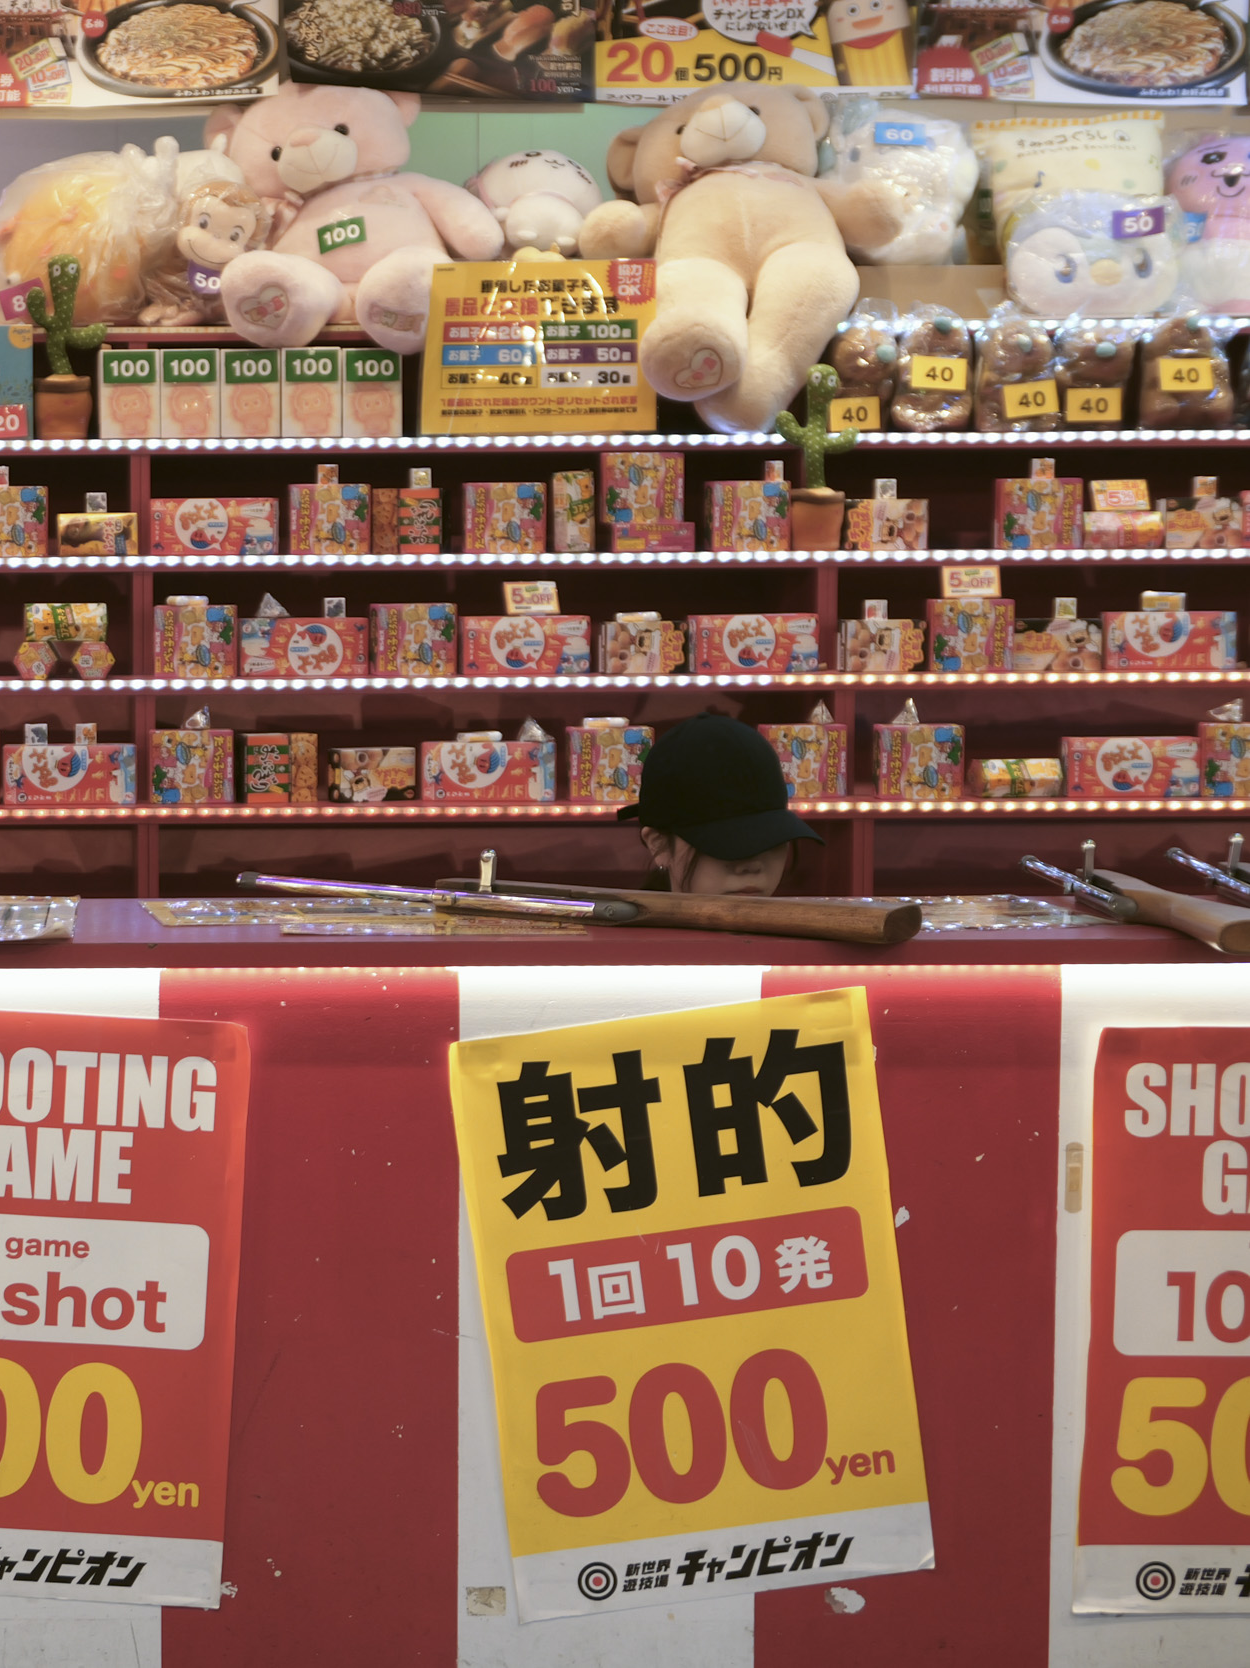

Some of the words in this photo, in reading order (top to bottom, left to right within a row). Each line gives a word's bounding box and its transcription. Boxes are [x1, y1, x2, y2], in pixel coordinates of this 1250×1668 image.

[885, 128, 914, 141] 60
[1123, 216, 1154, 232] 50
[322, 224, 361, 245] 100
[195, 273, 221, 289] 50
[618, 285, 642, 296] OK
[110, 359, 150, 377] 100
[170, 358, 210, 376] 100
[232, 359, 272, 377] 100
[292, 358, 333, 376] 100
[354, 359, 394, 377] 100
[925, 366, 954, 383] 40
[1173, 368, 1200, 384] 40
[1018, 392, 1046, 408] 40
[1080, 398, 1108, 414] 40
[842, 407, 868, 422] 40
[496, 1028, 853, 1221] 射的
[1202, 1140, 1250, 1216] G
[625, 1558, 671, 1577] 新世界
[676, 1531, 855, 1587] チャンピオン
[1183, 1567, 1232, 1581] 新世界
[621, 1574, 670, 1593] 遊技場
[1178, 1582, 1227, 1596] 遊技場
